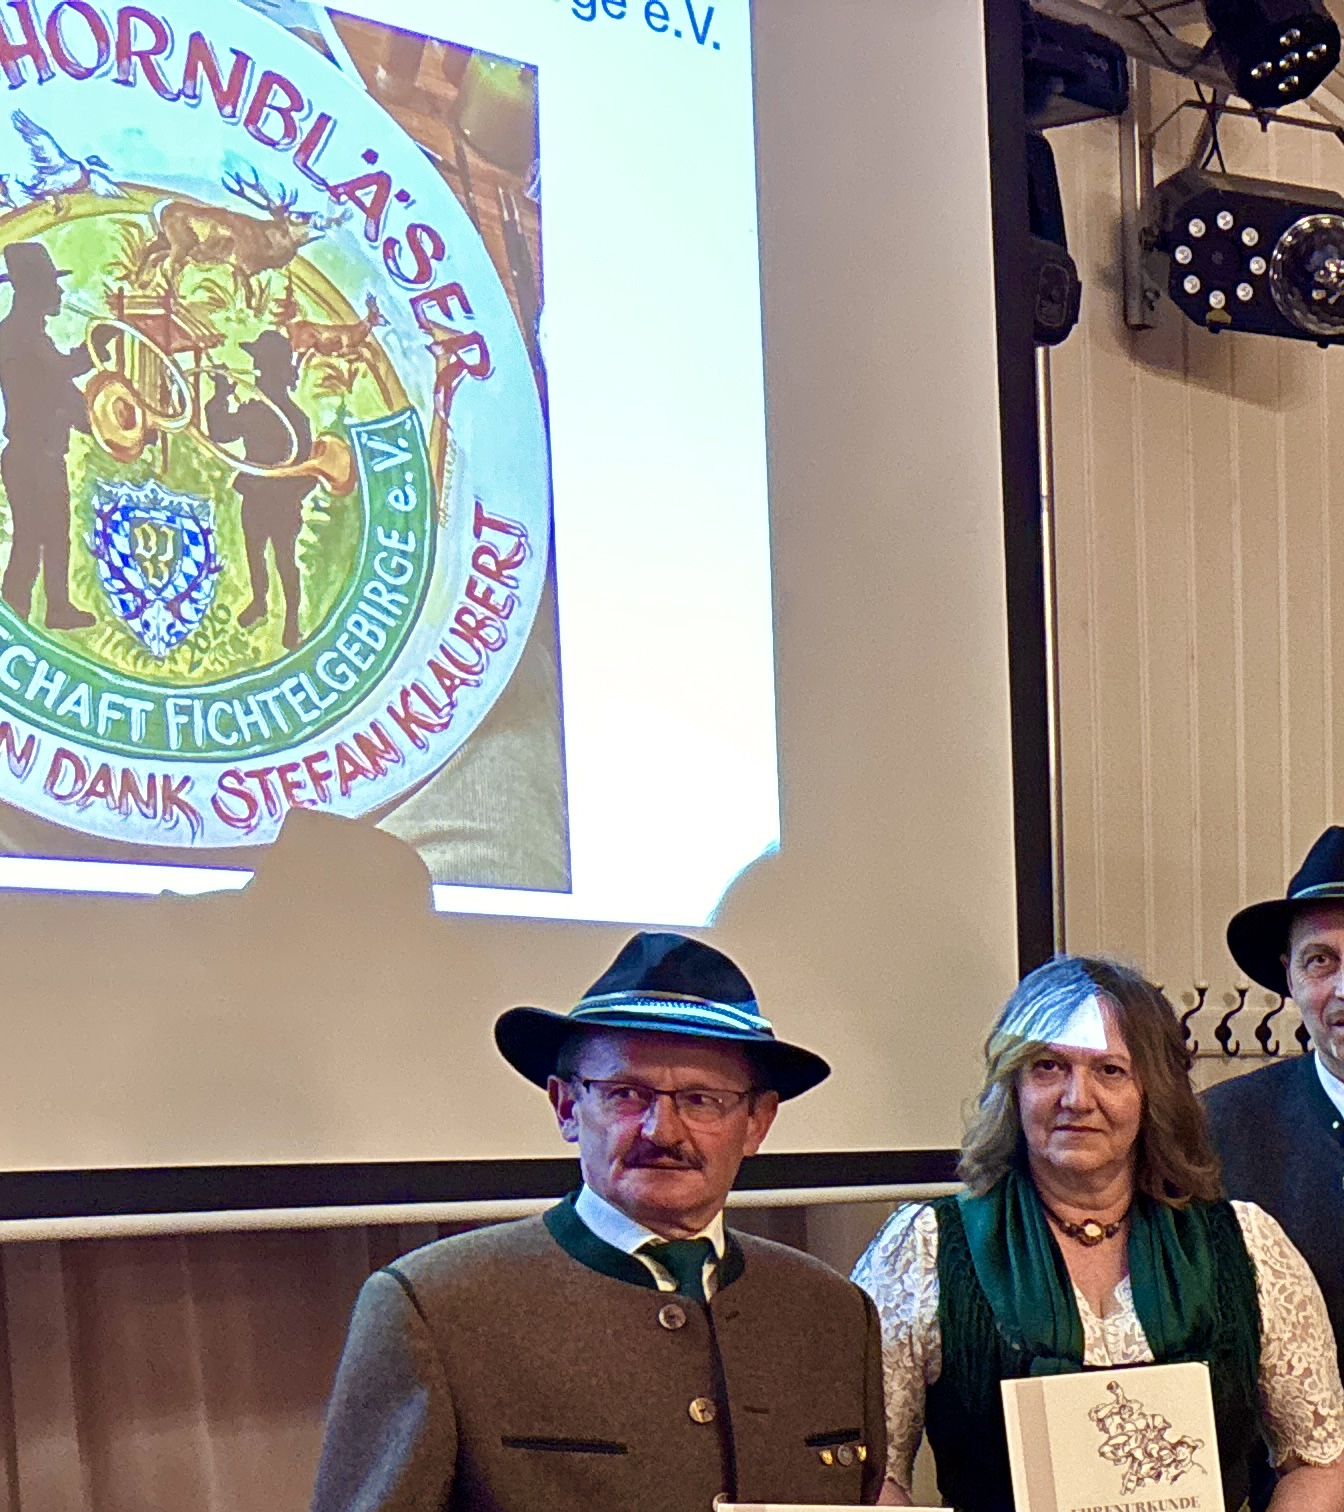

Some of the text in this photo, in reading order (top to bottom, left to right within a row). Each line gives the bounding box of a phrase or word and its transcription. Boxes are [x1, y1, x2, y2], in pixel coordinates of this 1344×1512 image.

[45, 746, 203, 844] DANK
[211, 721, 402, 834] STEFAN
[387, 498, 530, 751] KLAUBERT
[165, 526, 417, 750] FICHTELGEBIRGE
